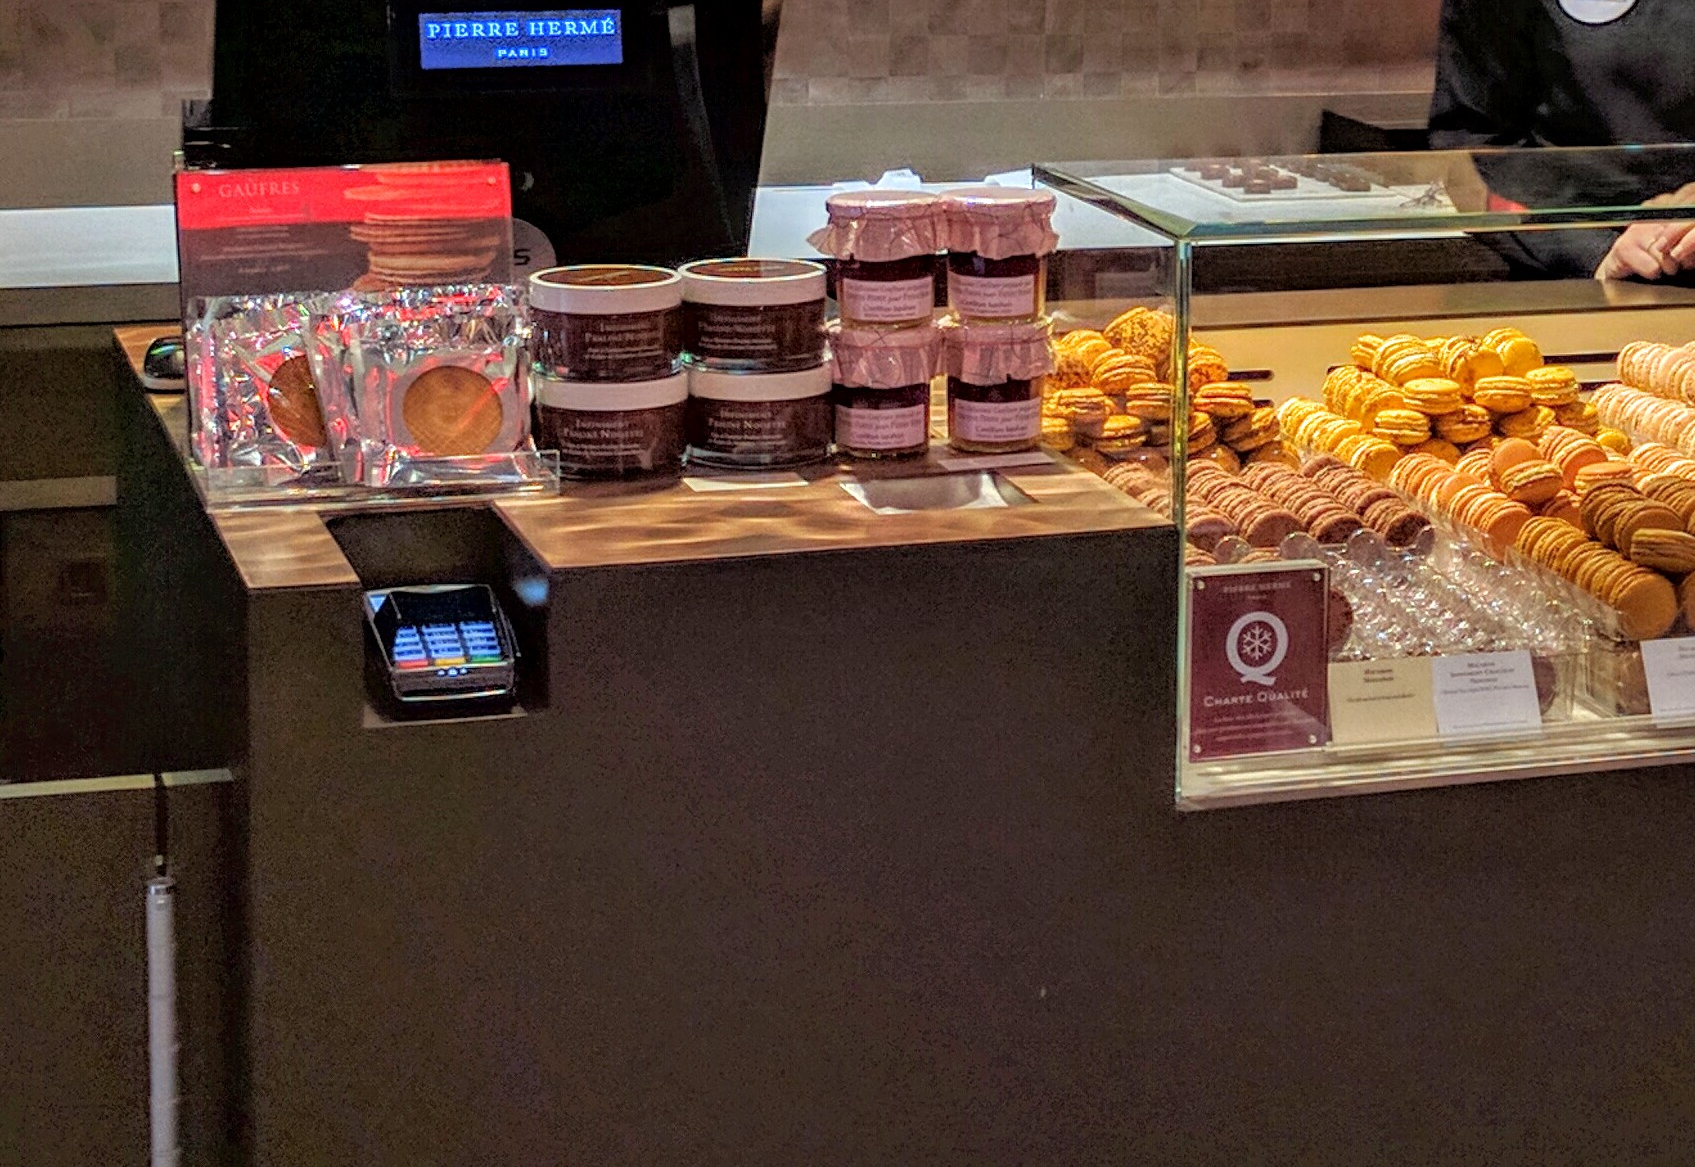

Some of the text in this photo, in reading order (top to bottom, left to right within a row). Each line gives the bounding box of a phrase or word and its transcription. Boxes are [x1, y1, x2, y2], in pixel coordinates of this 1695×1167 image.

[426, 17, 616, 38] PIERRE HERMÉ
[497, 47, 548, 58] PARIS
